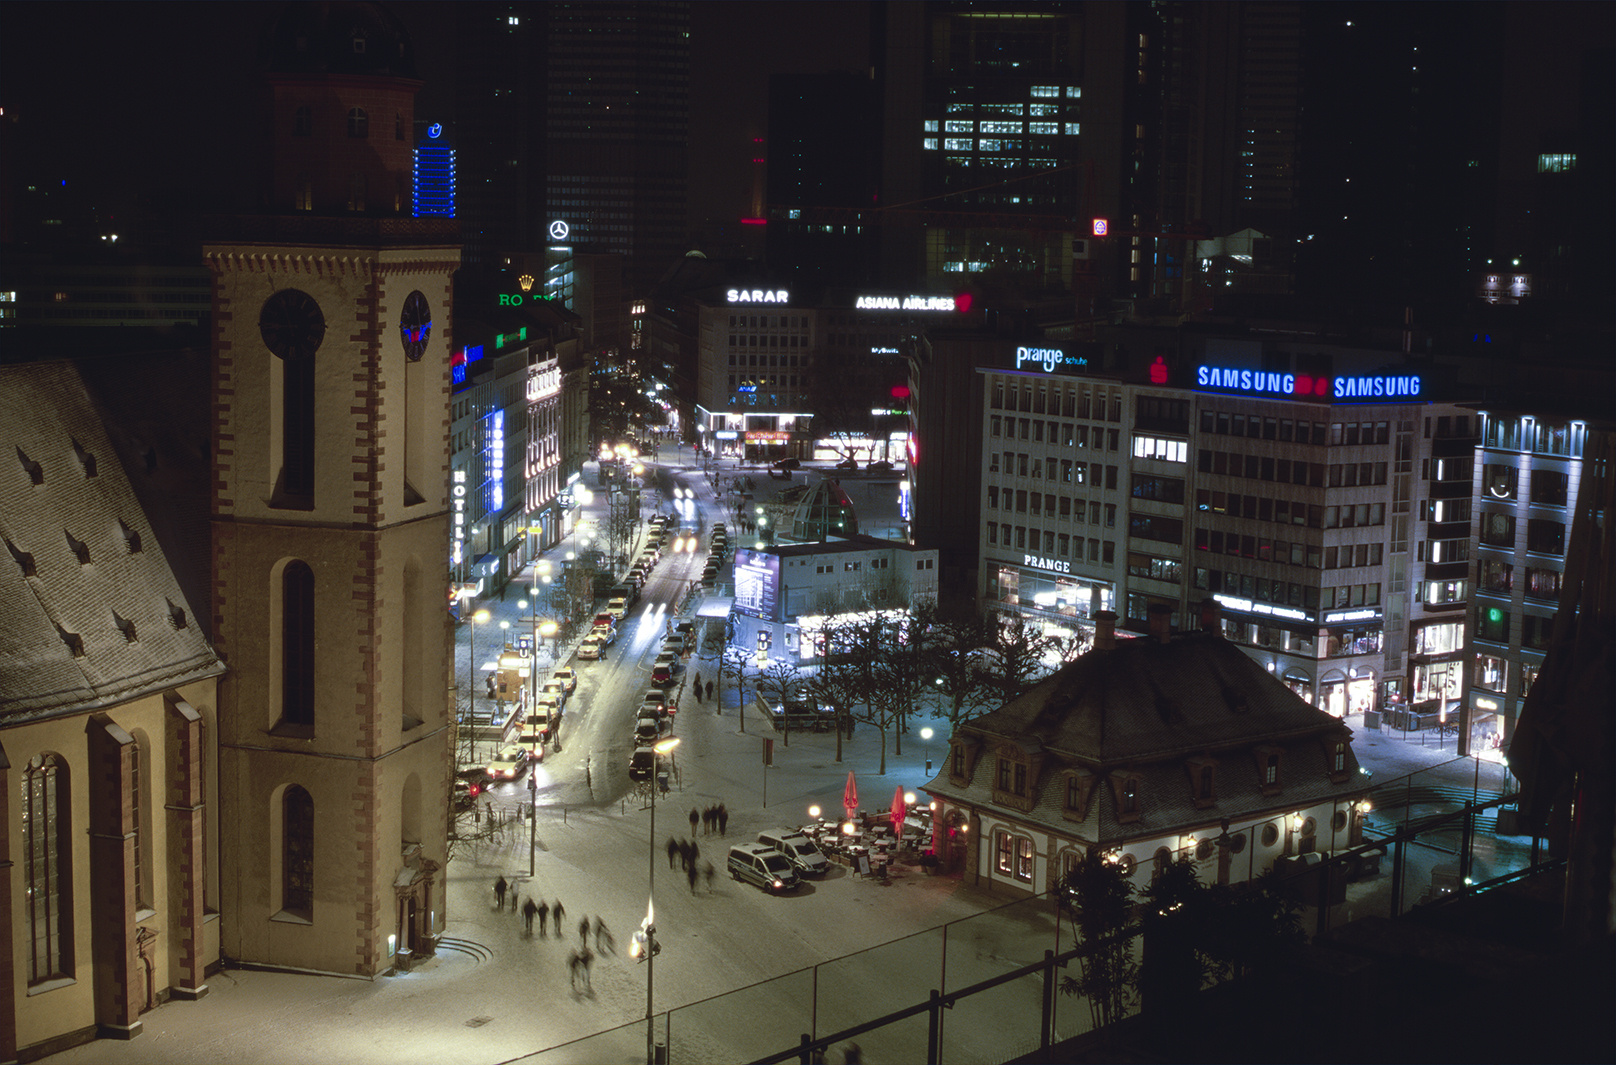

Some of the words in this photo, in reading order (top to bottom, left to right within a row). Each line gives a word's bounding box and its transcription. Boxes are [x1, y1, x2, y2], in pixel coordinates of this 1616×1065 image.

[498, 294, 554, 306] ROX
[727, 289, 788, 303] SARAR
[856, 297, 900, 309] ASIANA
[902, 298, 955, 311] AIRLINES
[1017, 347, 1063, 372] prange
[1065, 356, 1088, 366] schuhe
[1198, 366, 1294, 394] SAMSUNG
[1334, 376, 1420, 397] SAMSUNG
[454, 471, 466, 538] HOTEL
[1024, 555, 1070, 573] PRANGE
[519, 649, 528, 658] U
[759, 641, 768, 650] U
